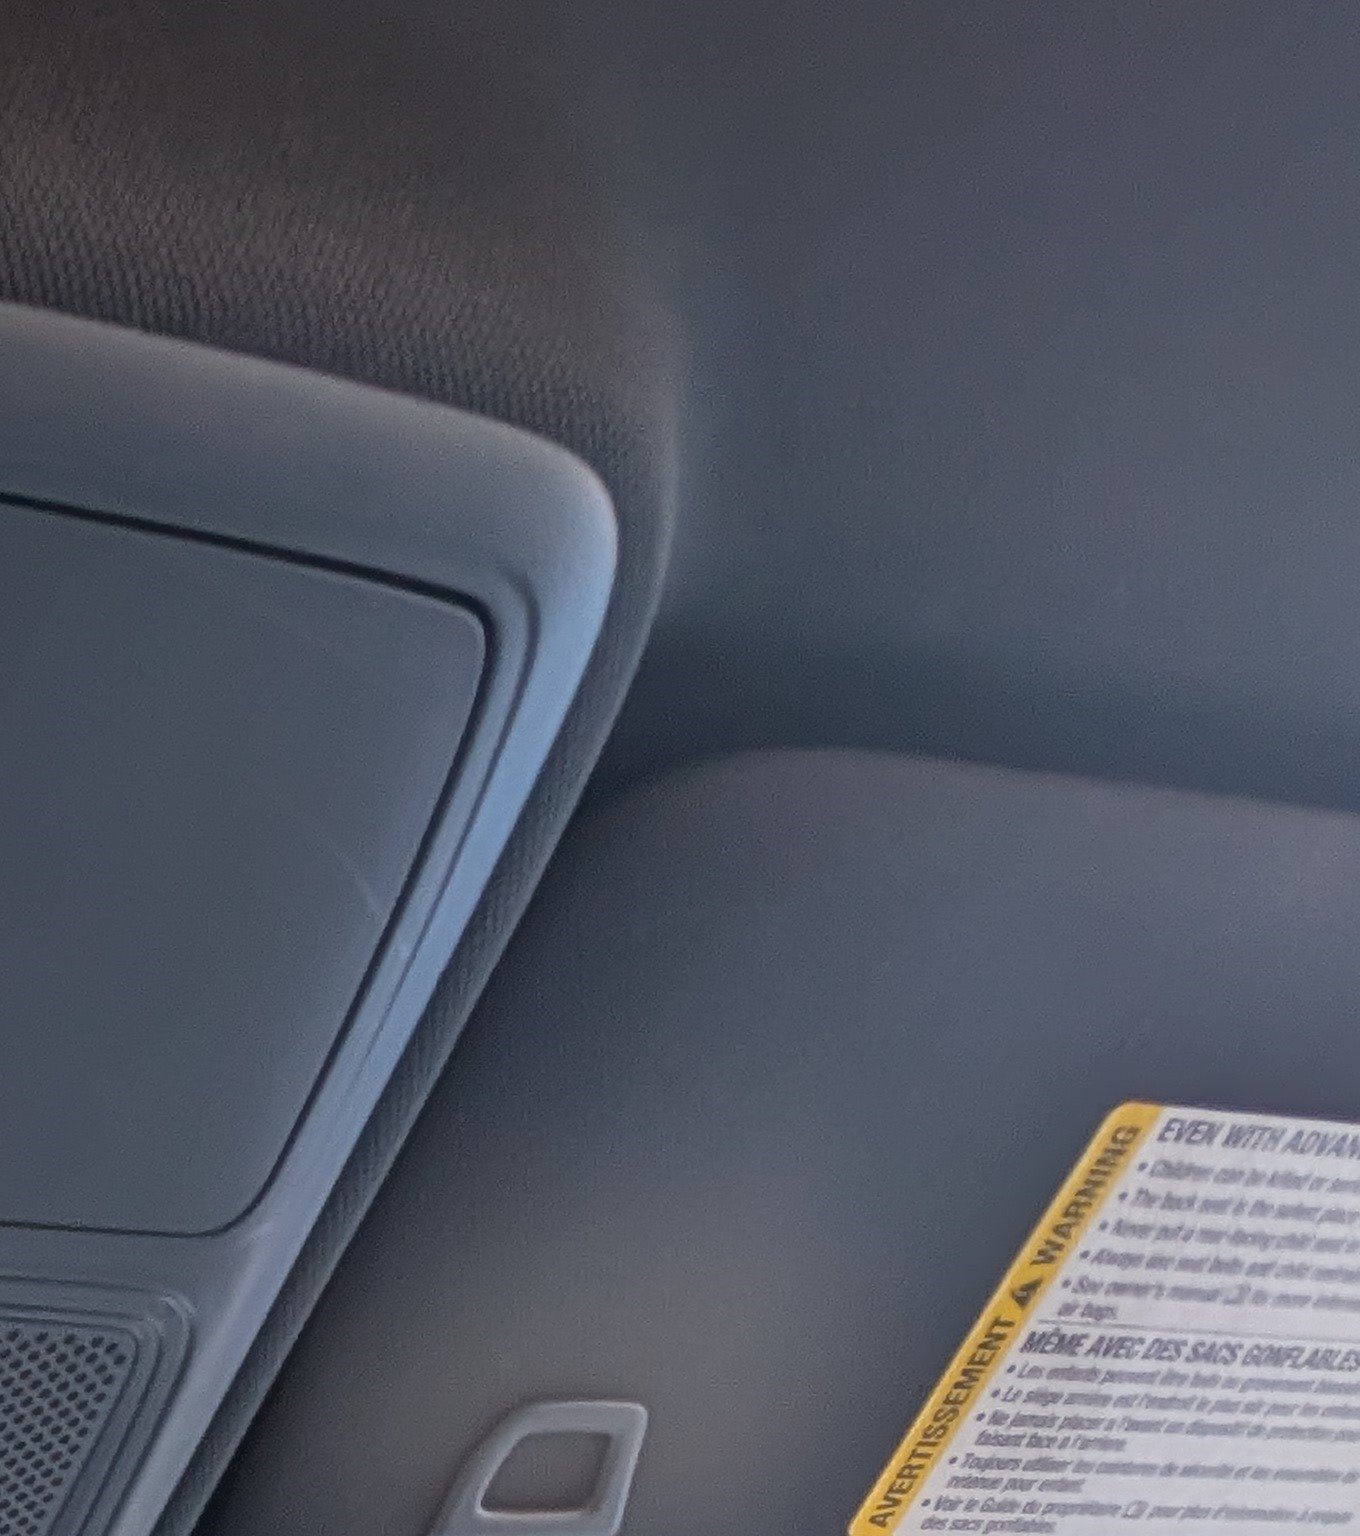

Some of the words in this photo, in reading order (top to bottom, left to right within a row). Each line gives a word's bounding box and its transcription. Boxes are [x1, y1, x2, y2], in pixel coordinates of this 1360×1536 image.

[1031, 1124, 1141, 1268] WARNING
[1157, 1117, 1223, 1147] EVEN
[868, 1315, 1016, 1529] AVERTISSEMENT
